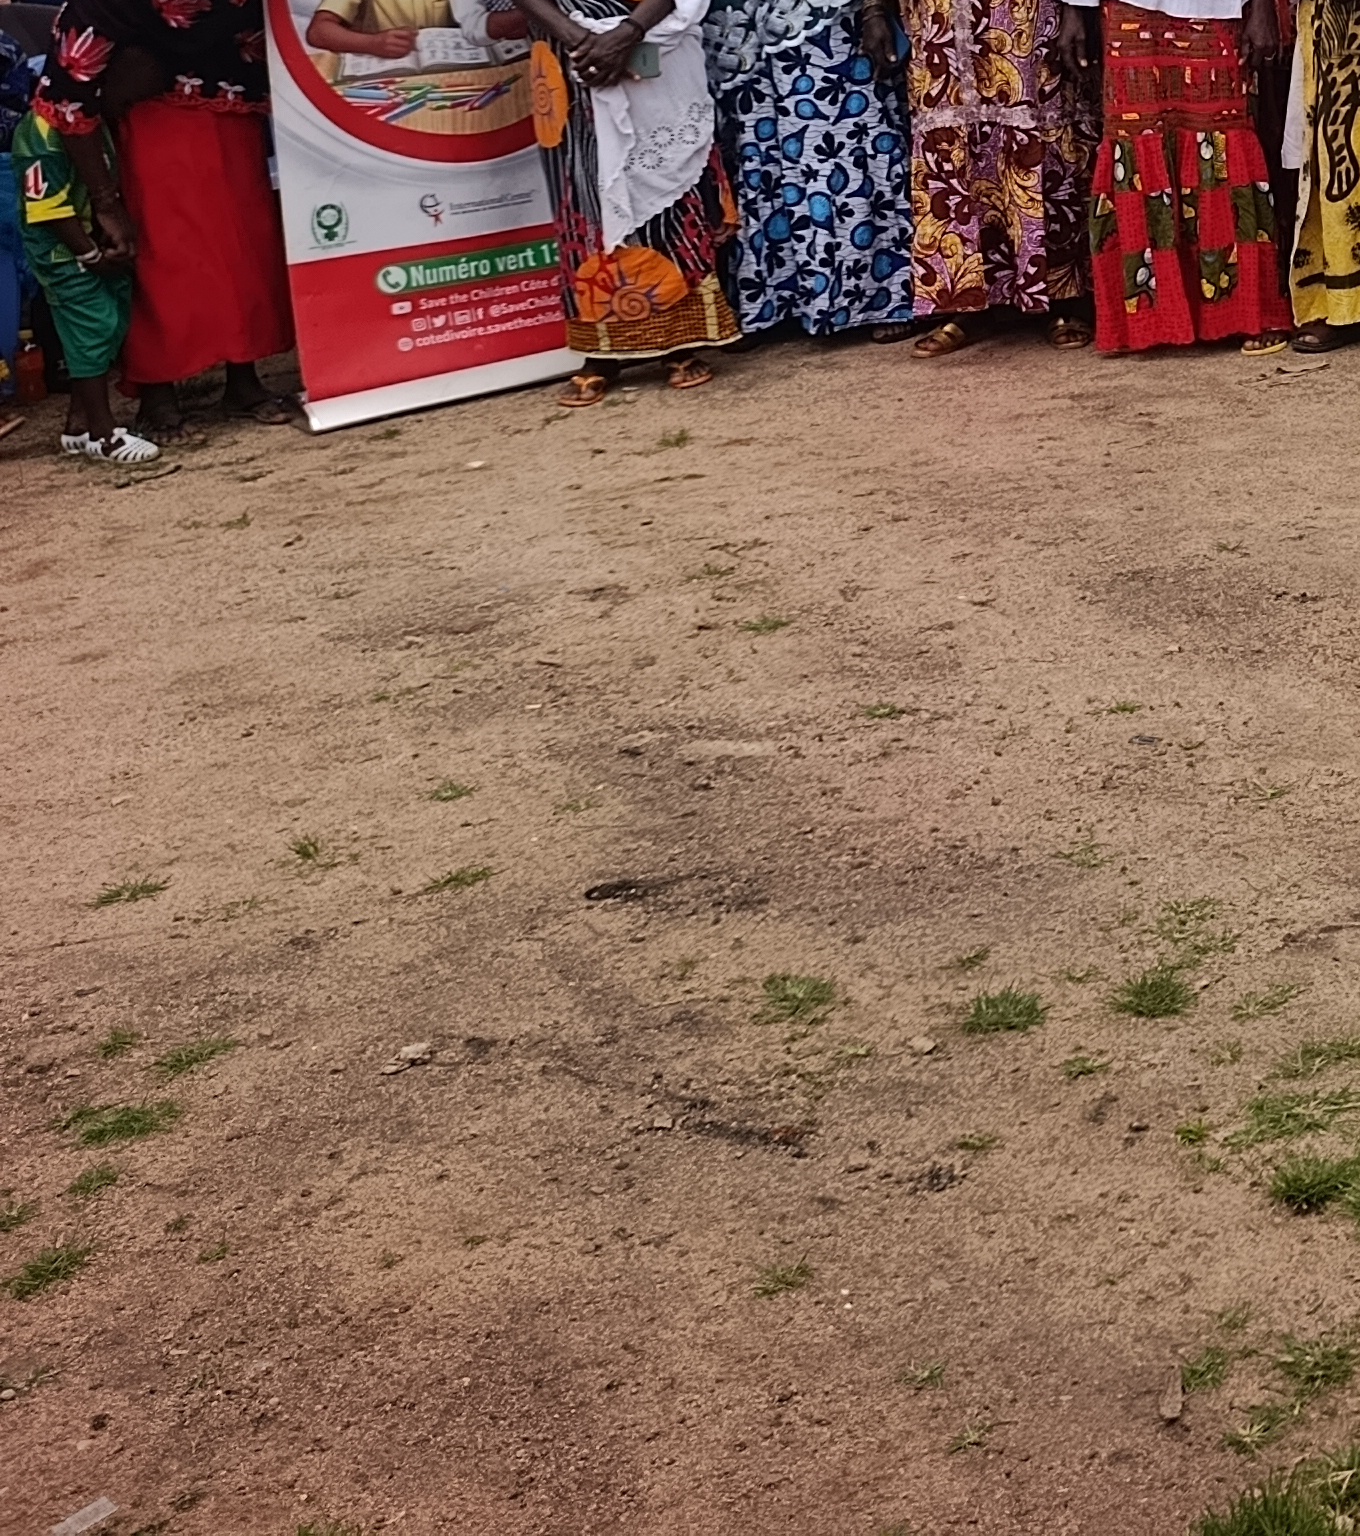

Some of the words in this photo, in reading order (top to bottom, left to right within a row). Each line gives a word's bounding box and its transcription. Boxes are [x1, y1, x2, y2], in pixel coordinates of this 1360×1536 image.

[409, 257, 491, 287] Numéro
[495, 247, 536, 272] vert
[419, 297, 447, 310] Save
[449, 292, 469, 304] the
[470, 284, 519, 300] Children
[520, 278, 549, 292] Côte
